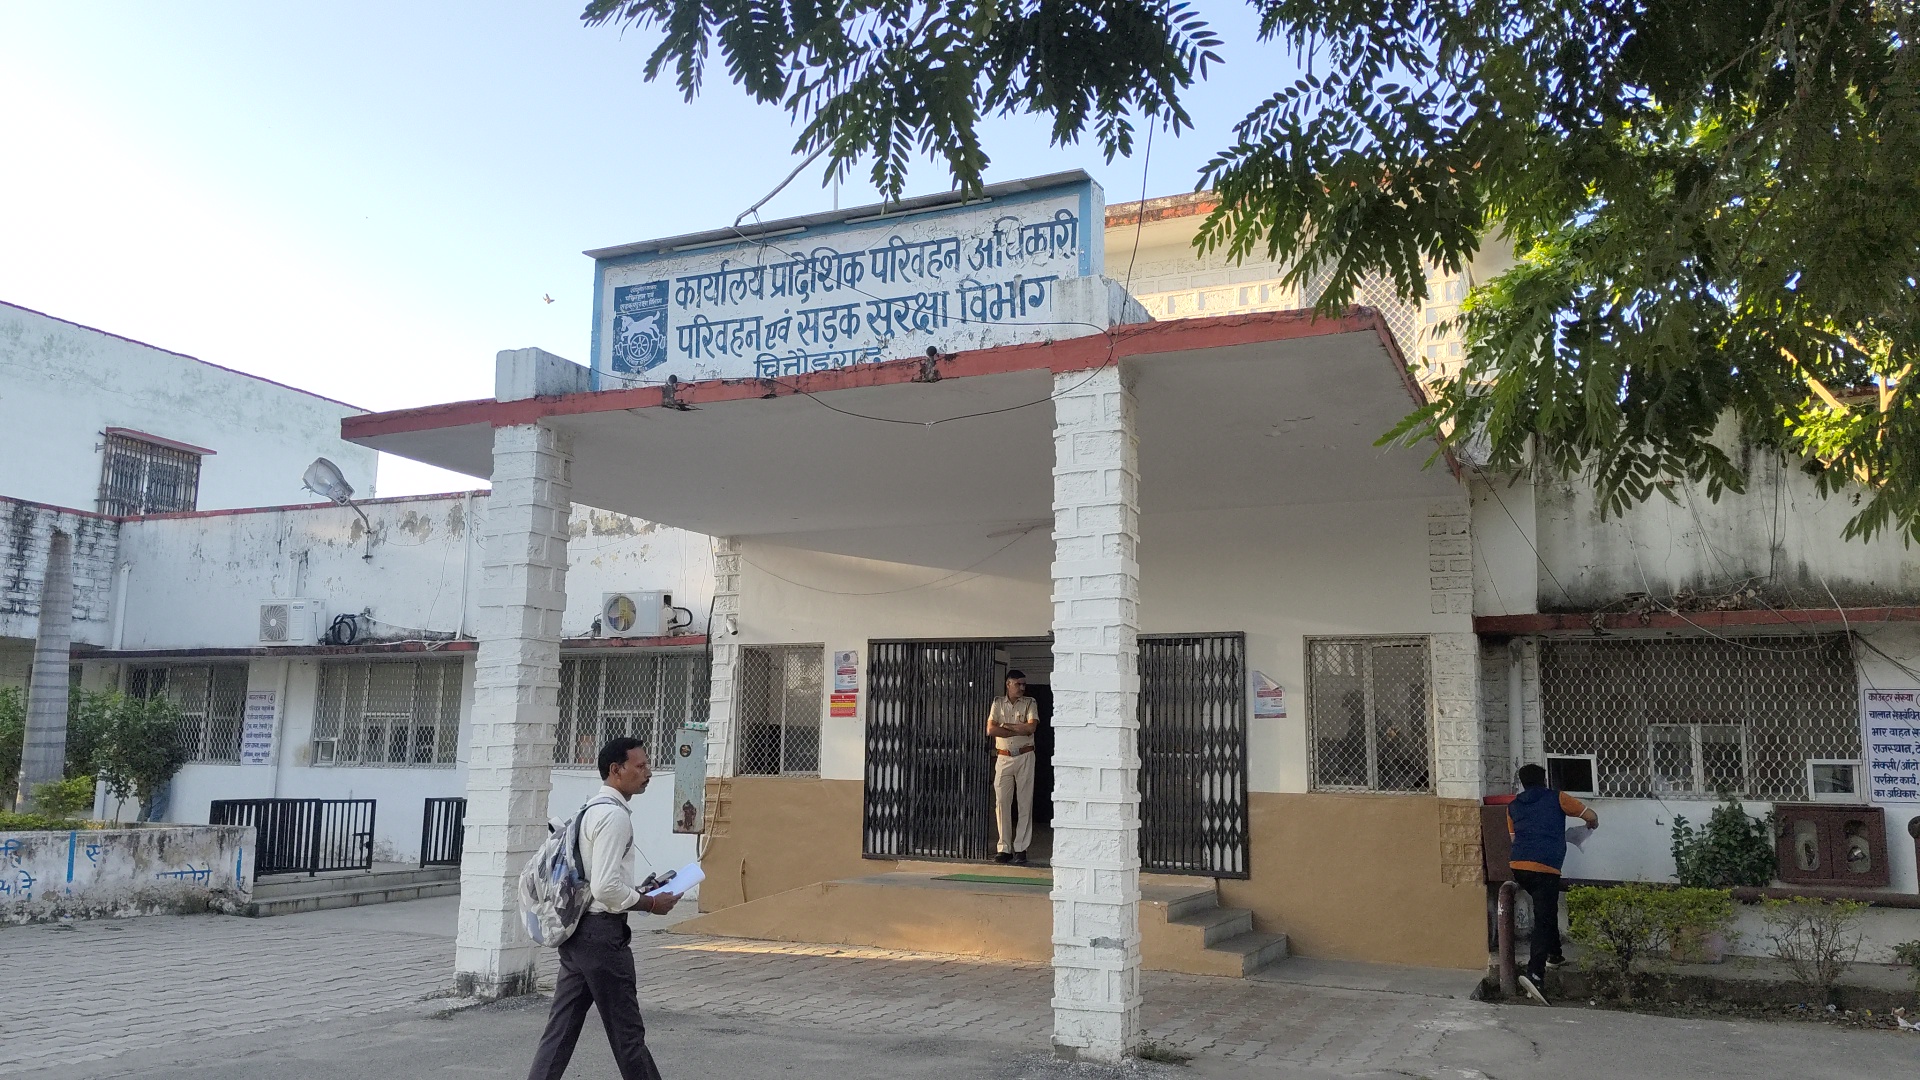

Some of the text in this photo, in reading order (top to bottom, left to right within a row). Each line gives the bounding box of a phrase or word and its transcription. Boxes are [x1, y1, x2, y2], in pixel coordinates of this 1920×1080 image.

[675, 208, 1079, 310] कार्यालय प्रादेशिक परिवहन अधिकारी
[675, 275, 1059, 359] परिवहन एवं सड़क सुरक्षा विभाग
[1893, 691, 1914, 703] संख्या
[1868, 710, 1891, 720] चालान
[1871, 727, 1888, 737] भार
[1889, 727, 1911, 739] वाहन
[1873, 773, 1898, 785] परमिट
[1873, 789, 1885, 798] का
